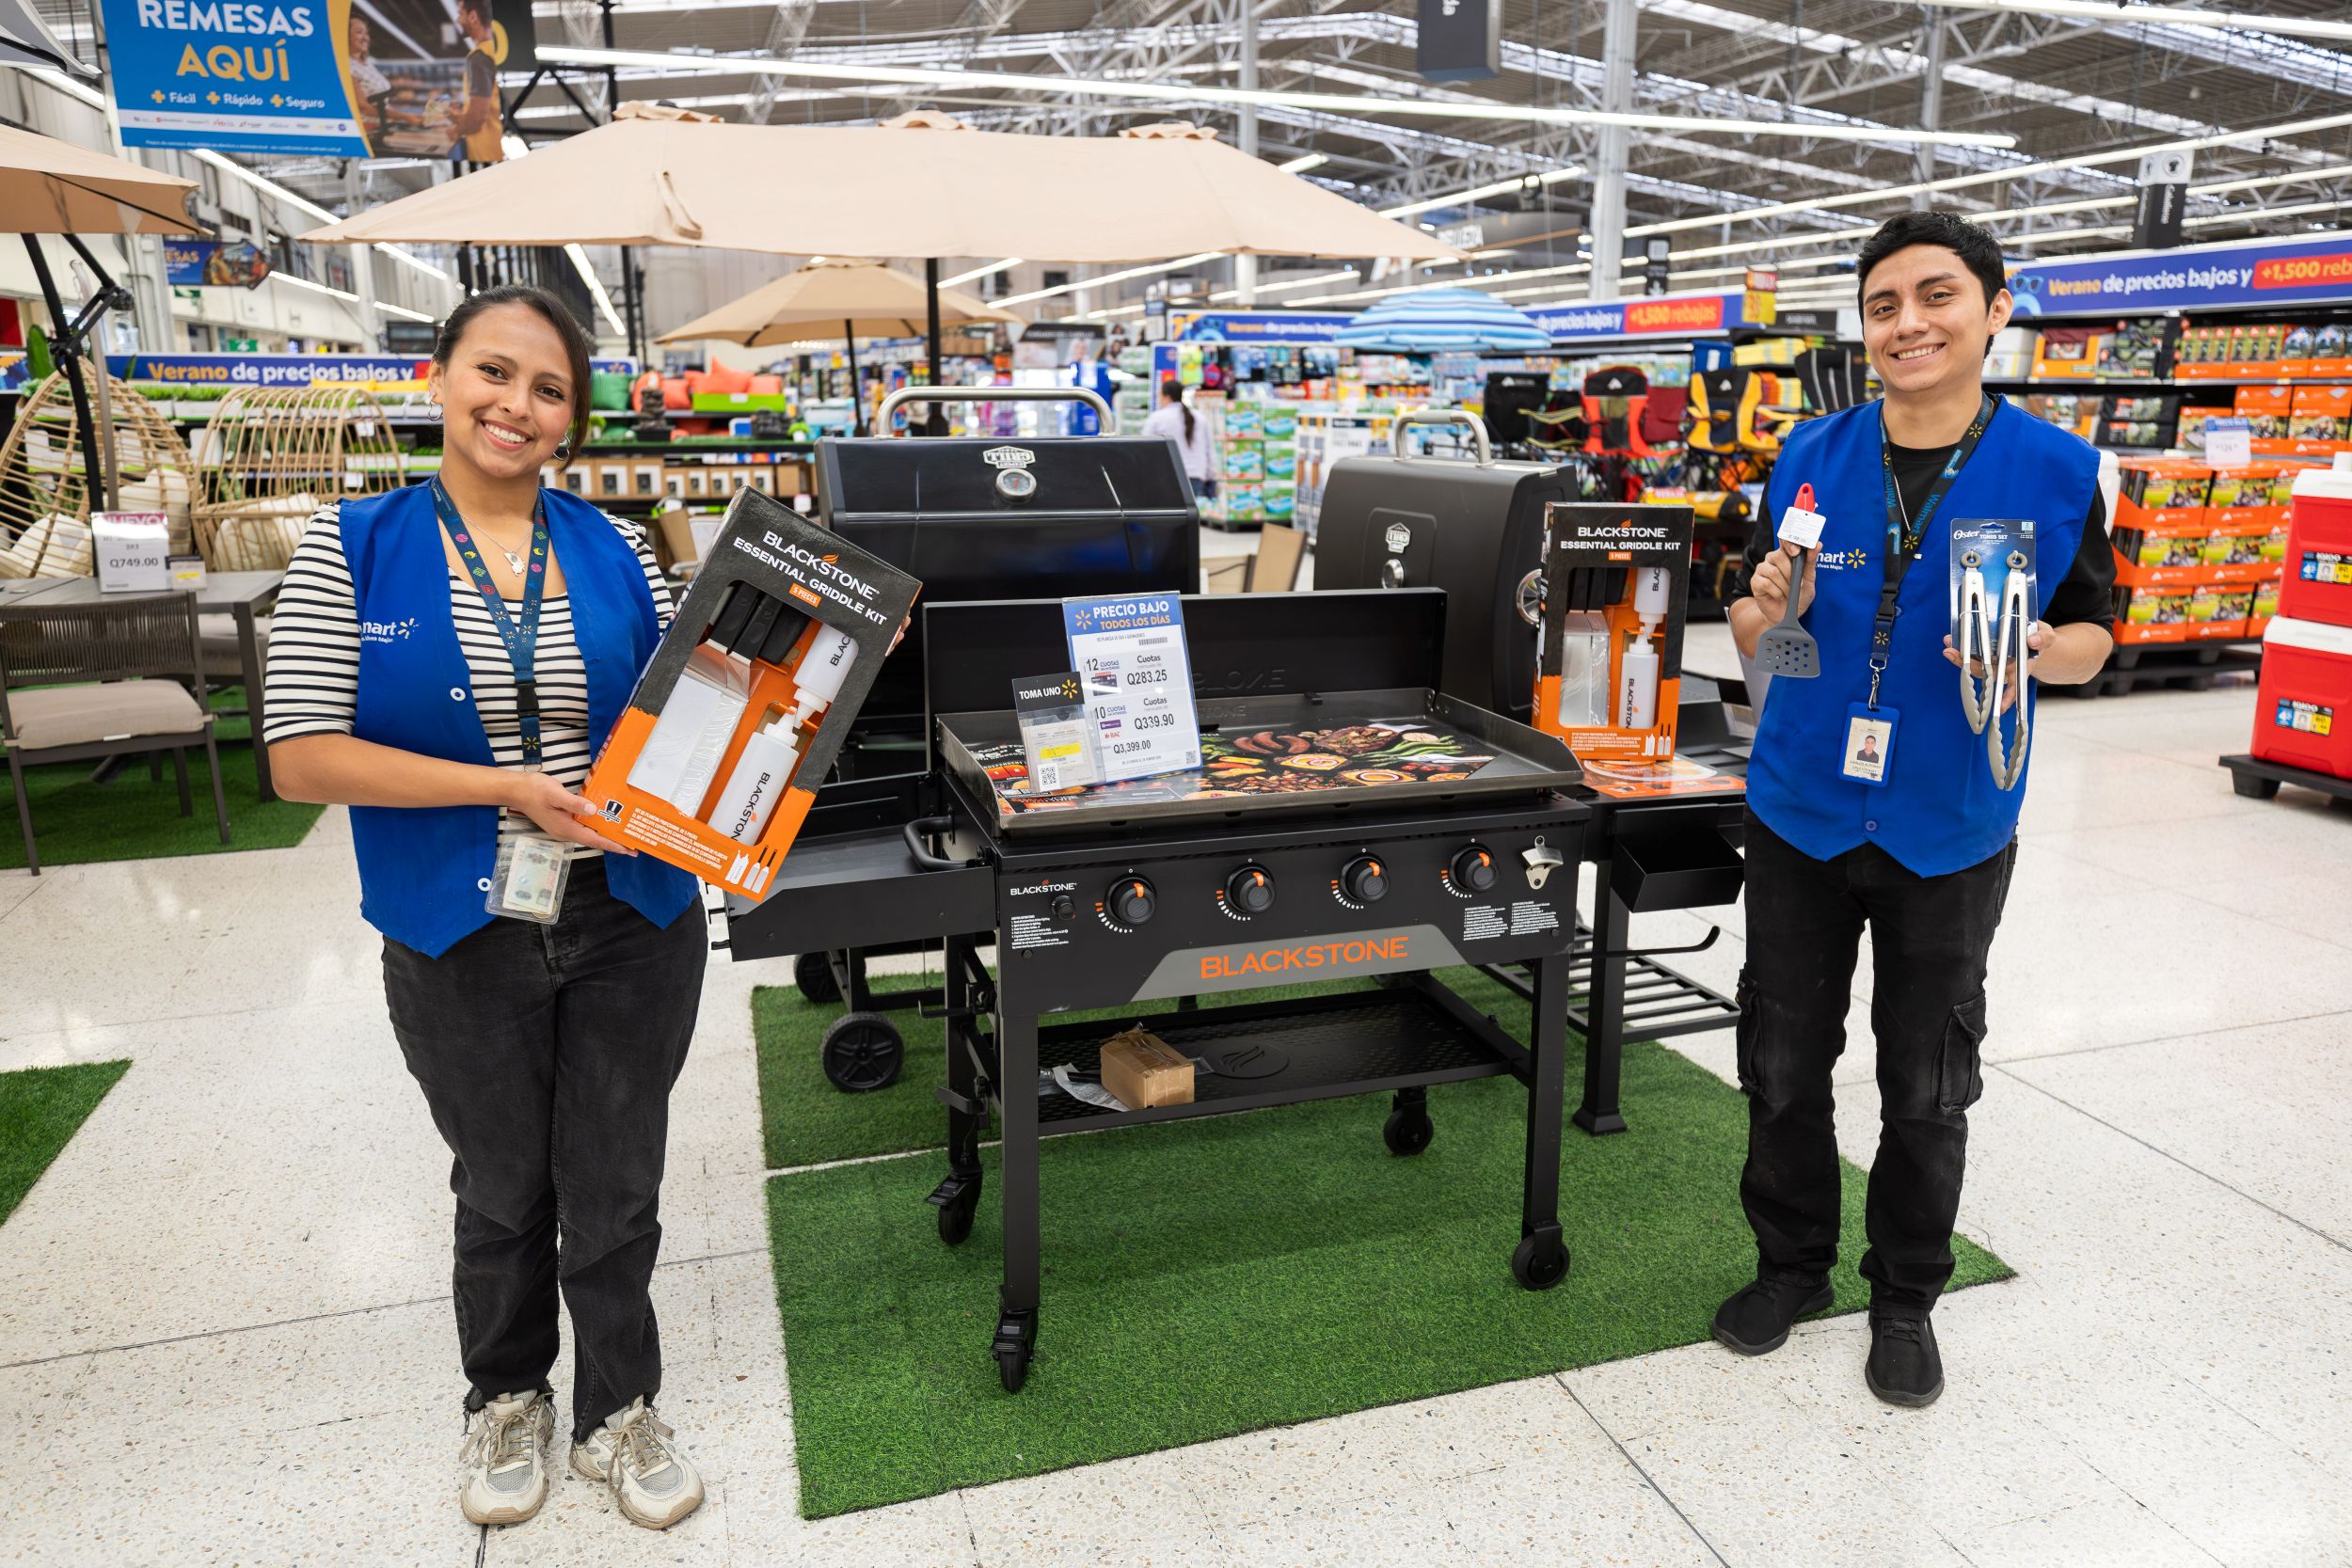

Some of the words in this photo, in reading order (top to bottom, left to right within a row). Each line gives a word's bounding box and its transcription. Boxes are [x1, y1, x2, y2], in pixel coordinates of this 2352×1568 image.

[138, 0, 314, 37] REMESAS
[176, 39, 290, 81] AQUÍ
[169, 92, 196, 103] Fácil
[224, 93, 262, 106] Rápido
[286, 97, 325, 110] Seguro
[2048, 277, 2101, 296] Verano
[2103, 274, 2123, 293] de
[2125, 269, 2185, 295] precios
[2187, 266, 2237, 291] bajos
[2239, 268, 2253, 288] y
[2262, 261, 2320, 282] +1,500
[148, 362, 228, 381] Verano
[232, 362, 260, 381] de
[263, 363, 339, 385] precios
[342, 362, 398, 382] bajos
[1912, 494, 1942, 533] Walmart
[1578, 527, 1665, 537] BLACKSTONE
[1953, 530, 1980, 540] Oster
[1560, 541, 1617, 550] ESSENTIAL
[1619, 542, 1662, 550] GRIDDLE
[1665, 542, 1680, 550] KIT
[109, 558, 159, 568] Q749.00
[1817, 551, 1845, 564] mart
[762, 531, 878, 600] BLACKSTONE
[733, 536, 806, 584] ESSENTIAL
[809, 578, 865, 614] GRIDDLE
[865, 608, 887, 626] KIT
[799, 589, 818, 605] PIECES
[1093, 603, 1136, 619] PRECIO
[1139, 600, 1169, 614] BAJO
[1100, 619, 1131, 630] TODOS
[1132, 617, 1150, 627] LOS
[1151, 612, 1170, 625] DÍAS
[359, 622, 396, 636] mart
[1087, 658, 1099, 672] 12
[1136, 655, 1161, 663] Cuotas
[1127, 669, 1168, 686] Q283.25
[1019, 689, 1042, 700] TOMA
[1042, 687, 1061, 698] UNO
[1143, 697, 1168, 706] Cuotas
[1625, 678, 1634, 729] BLACKSTON
[1094, 706, 1105, 720] 10
[1134, 713, 1174, 730] Q339.90
[1113, 739, 1152, 755] Q3,399.00
[1010, 882, 1075, 895] BLACKSTONE
[1200, 936, 1408, 979] BLACKSTONE
